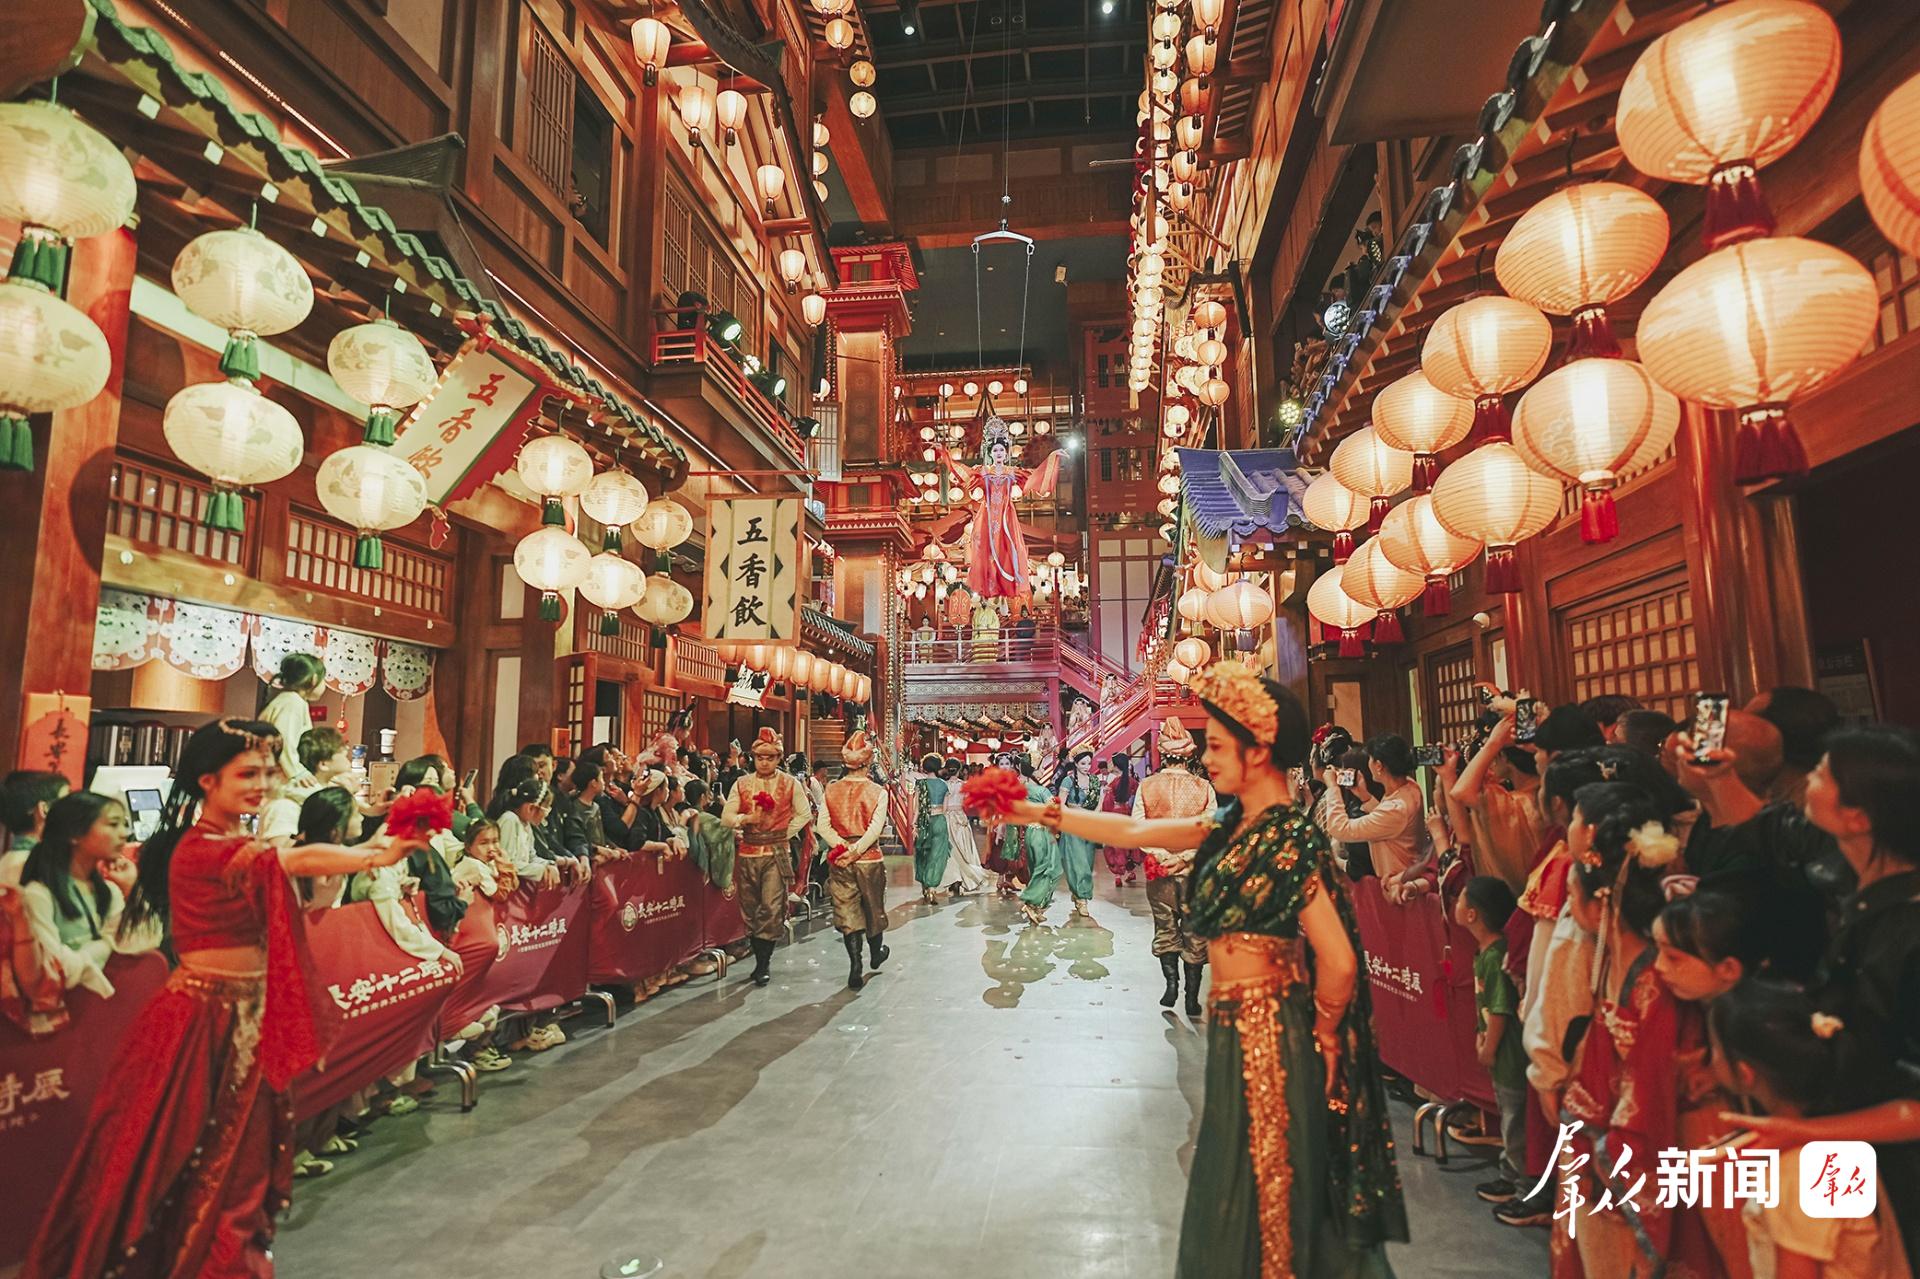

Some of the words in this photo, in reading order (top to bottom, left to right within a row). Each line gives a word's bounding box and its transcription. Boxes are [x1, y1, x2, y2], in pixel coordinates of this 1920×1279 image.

[408, 373, 505, 479] 五香飲
[730, 517, 768, 627] 五香飲
[328, 960, 453, 1010] 長安十二時
